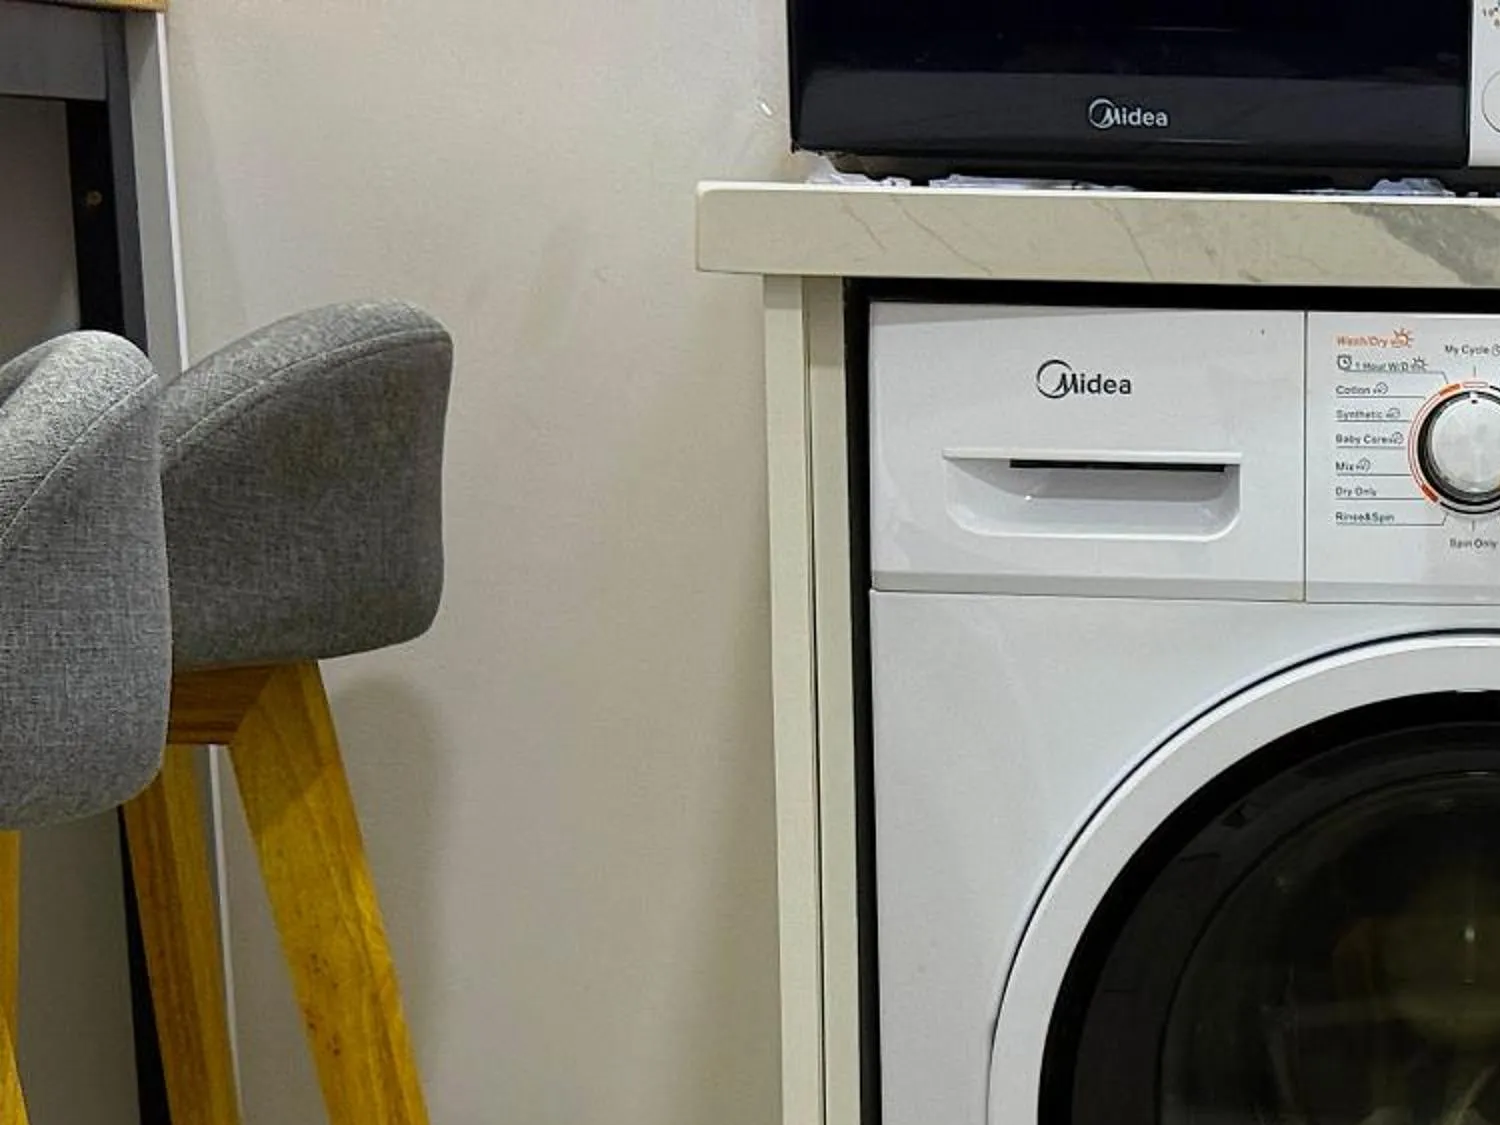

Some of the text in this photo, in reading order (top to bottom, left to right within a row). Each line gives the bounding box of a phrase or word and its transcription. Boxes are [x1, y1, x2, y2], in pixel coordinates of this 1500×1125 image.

[1088, 98, 1169, 129] Midea
[1461, 345, 1490, 355] Cycle
[1036, 359, 1132, 399] Midea
[1336, 384, 1371, 395] Cotton
[1336, 409, 1384, 421] Synthetic
[1336, 434, 1361, 445] Baby
[1336, 461, 1354, 471] Mix
[1336, 487, 1353, 498] Dry
